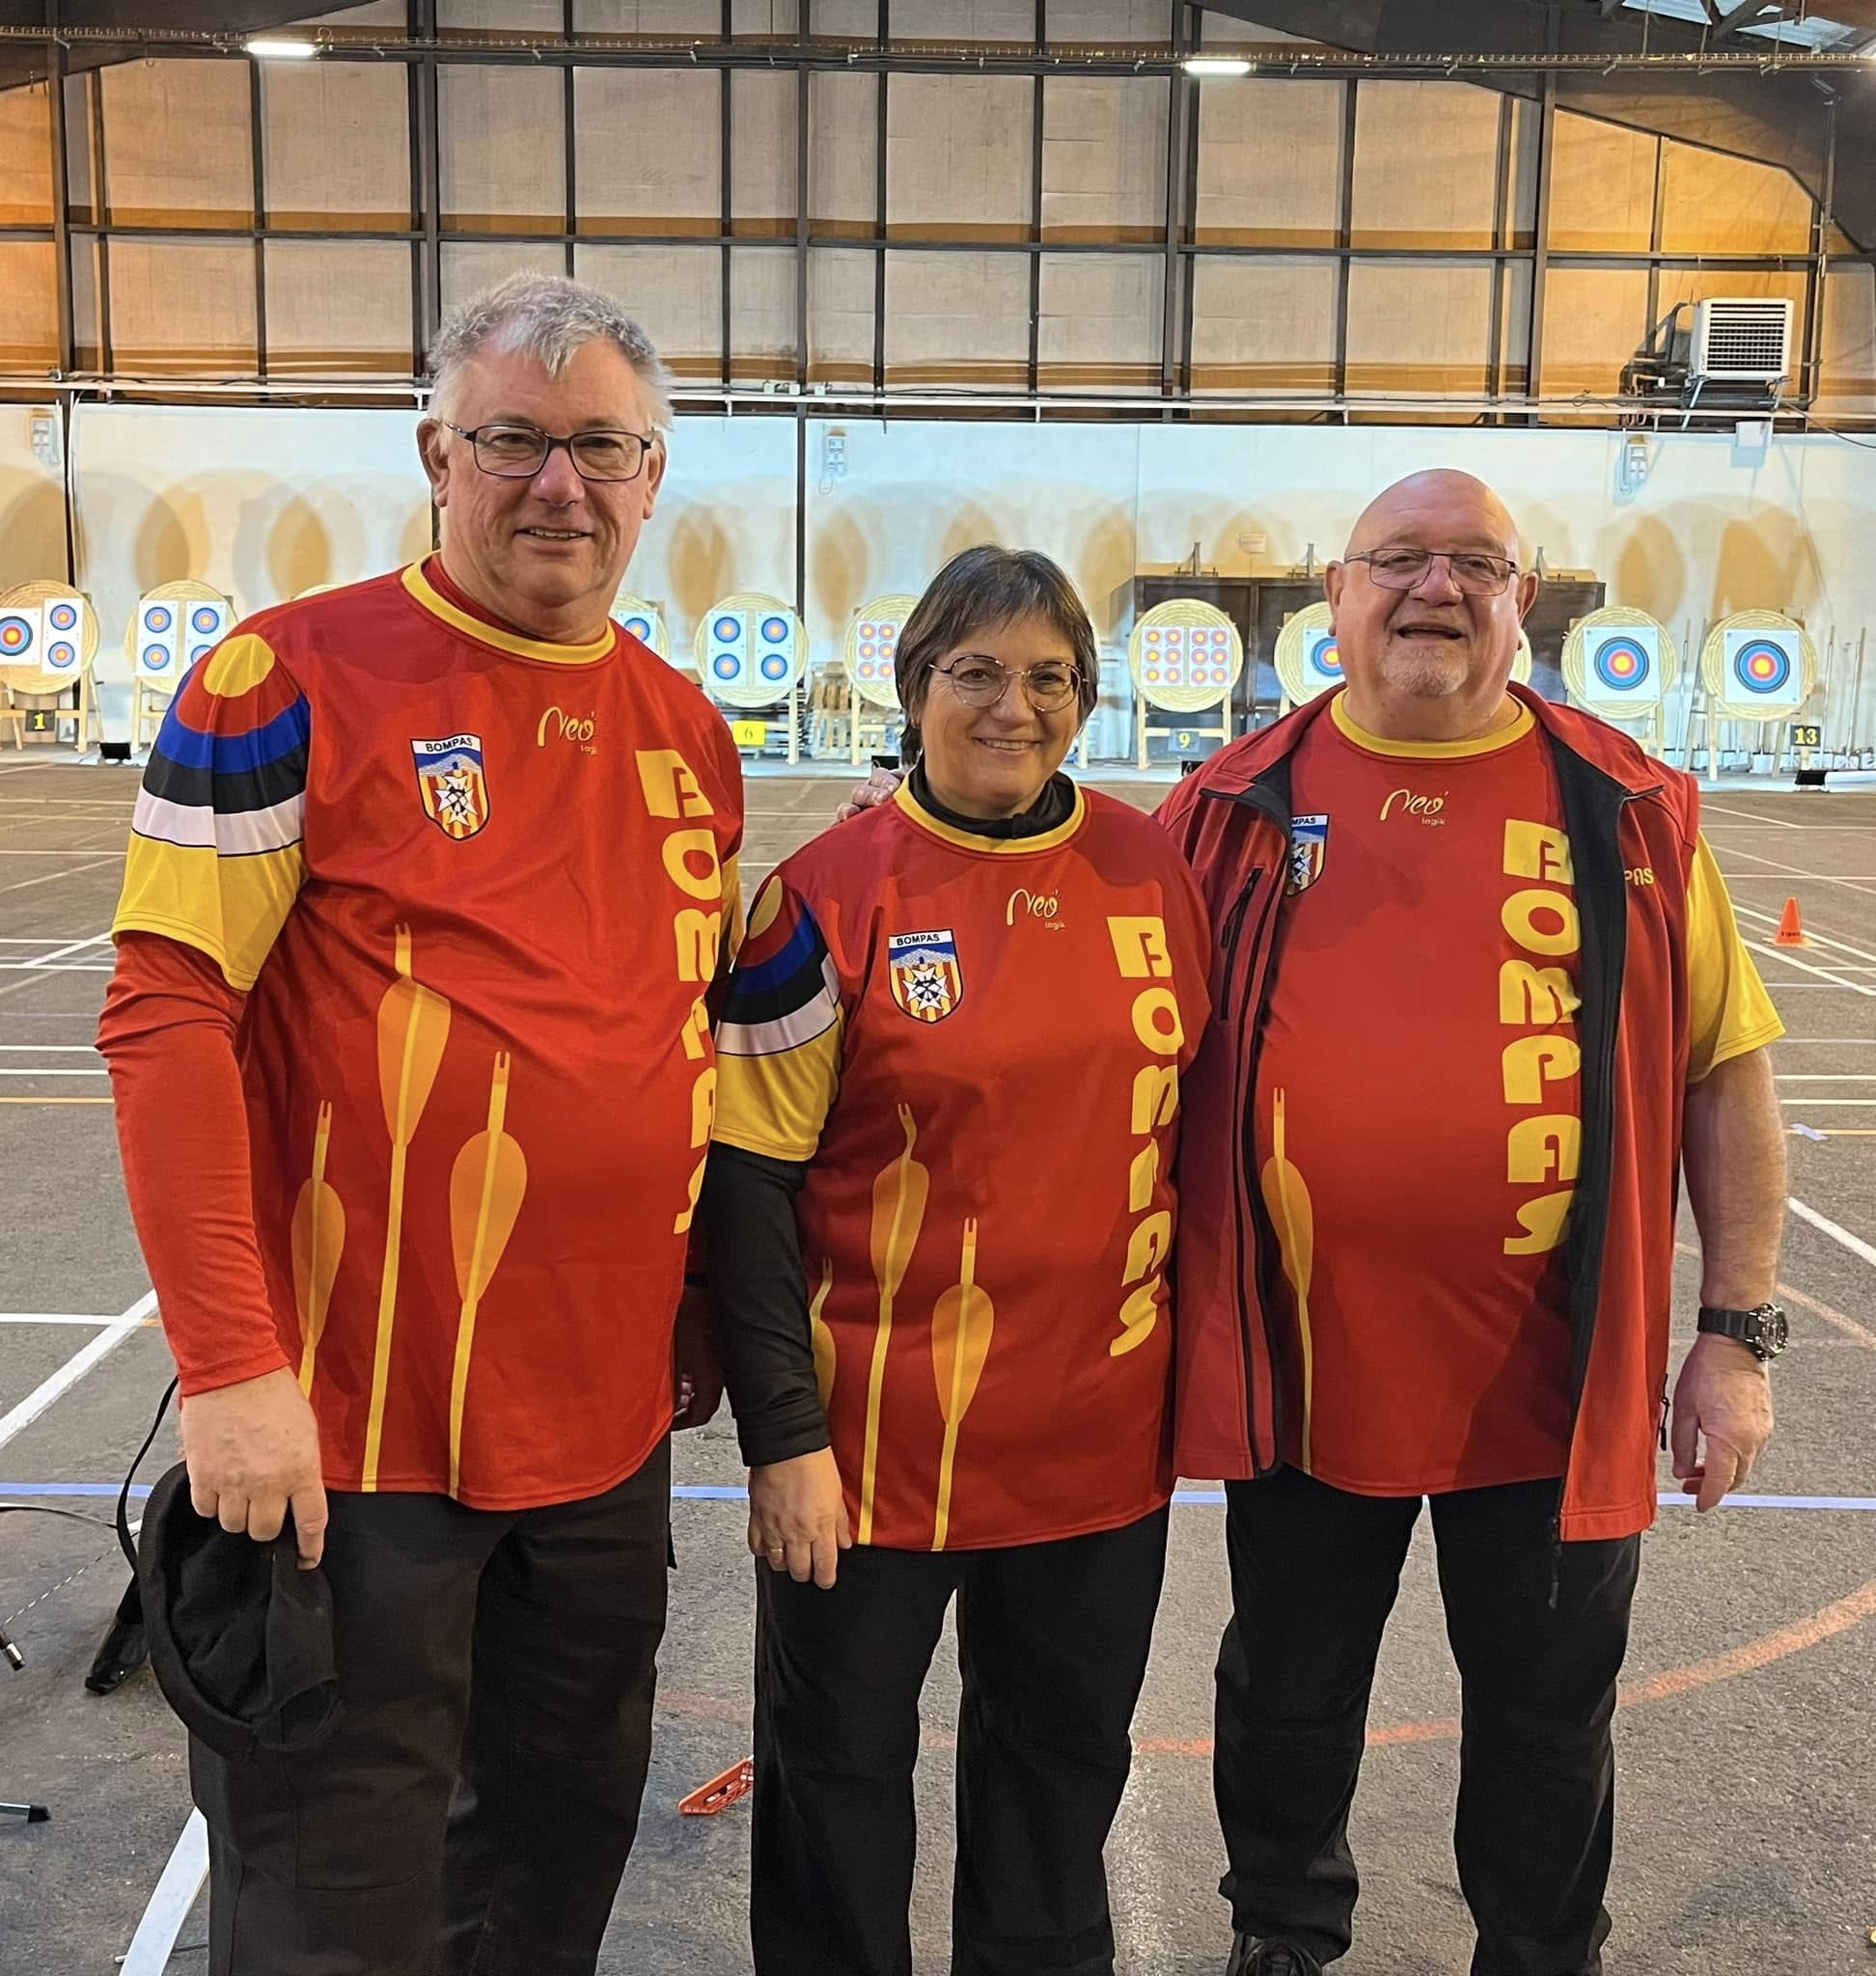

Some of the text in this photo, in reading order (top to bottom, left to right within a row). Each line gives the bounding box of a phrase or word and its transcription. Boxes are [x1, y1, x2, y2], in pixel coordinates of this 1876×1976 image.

[34, 712, 46, 730] 1
[744, 727, 753, 739] 6
[1178, 732, 1190, 749] 9
[1795, 727, 1817, 745] 13
[426, 736, 473, 753] BOMPAS
[1623, 866, 1655, 886] PAS
[897, 933, 940, 947] BOMPAS
[1499, 818, 1583, 1255] BOMPAS
